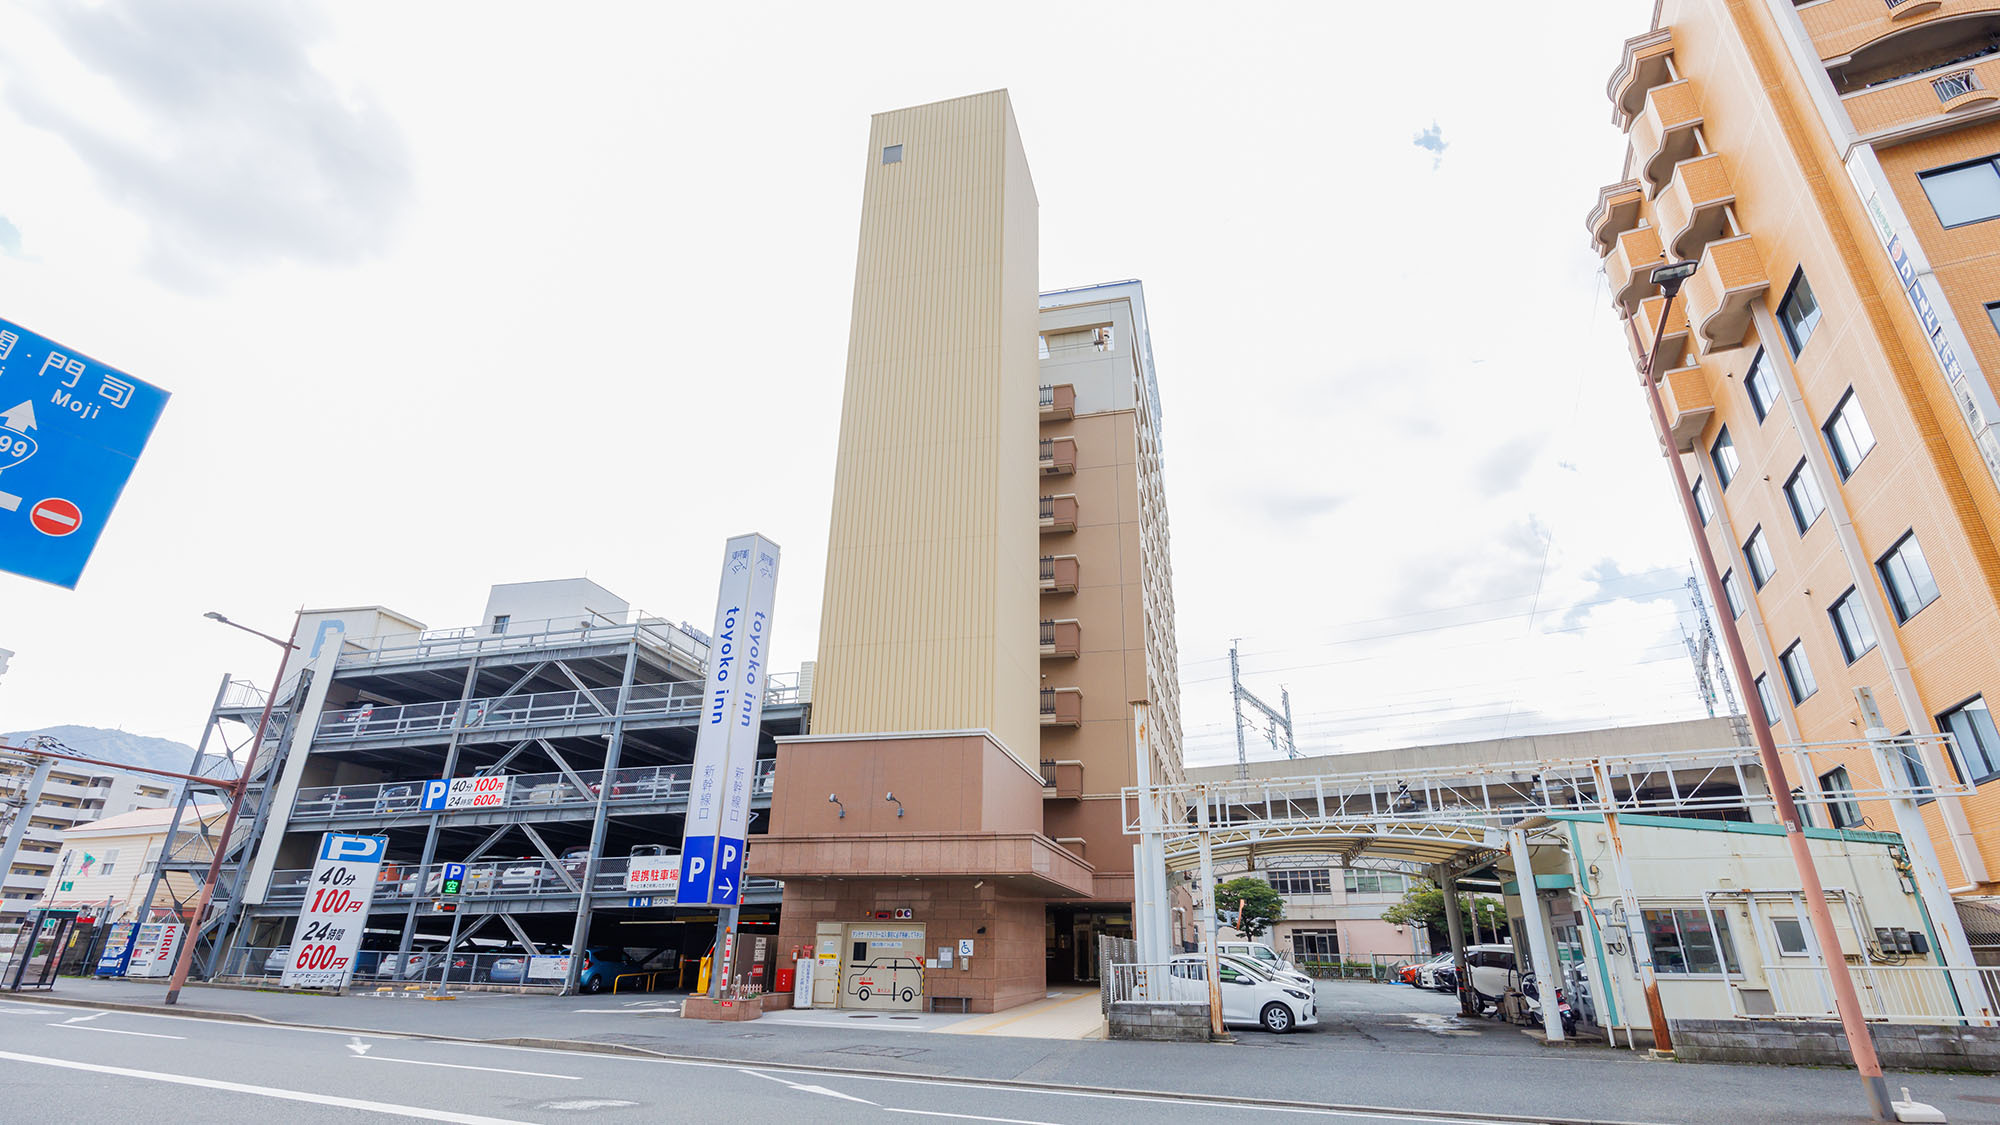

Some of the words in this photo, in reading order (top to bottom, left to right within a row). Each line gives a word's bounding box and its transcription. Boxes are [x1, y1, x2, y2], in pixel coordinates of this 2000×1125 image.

[50, 388, 102, 421] Moji
[717, 605, 740, 682] toyoko
[746, 610, 766, 686] toyoko
[711, 688, 730, 725] inn
[740, 690, 757, 728] inn
[425, 781, 447, 809] P
[451, 780, 473, 793] 40分
[473, 777, 505, 793] 100円
[698, 764, 715, 820] 新幹線口
[473, 793, 502, 806] 600円
[327, 835, 378, 860] P
[721, 844, 737, 870] P
[318, 866, 357, 886] 40分
[449, 865, 462, 879] P
[630, 868, 679, 882] 提携駐車場
[687, 856, 706, 883] P
[310, 887, 364, 914] 100円
[445, 880, 459, 894] 空
[632, 897, 649, 907] IN
[157, 925, 177, 961] KIRIN
[301, 920, 346, 942] 24時間
[296, 943, 349, 971] 600円
